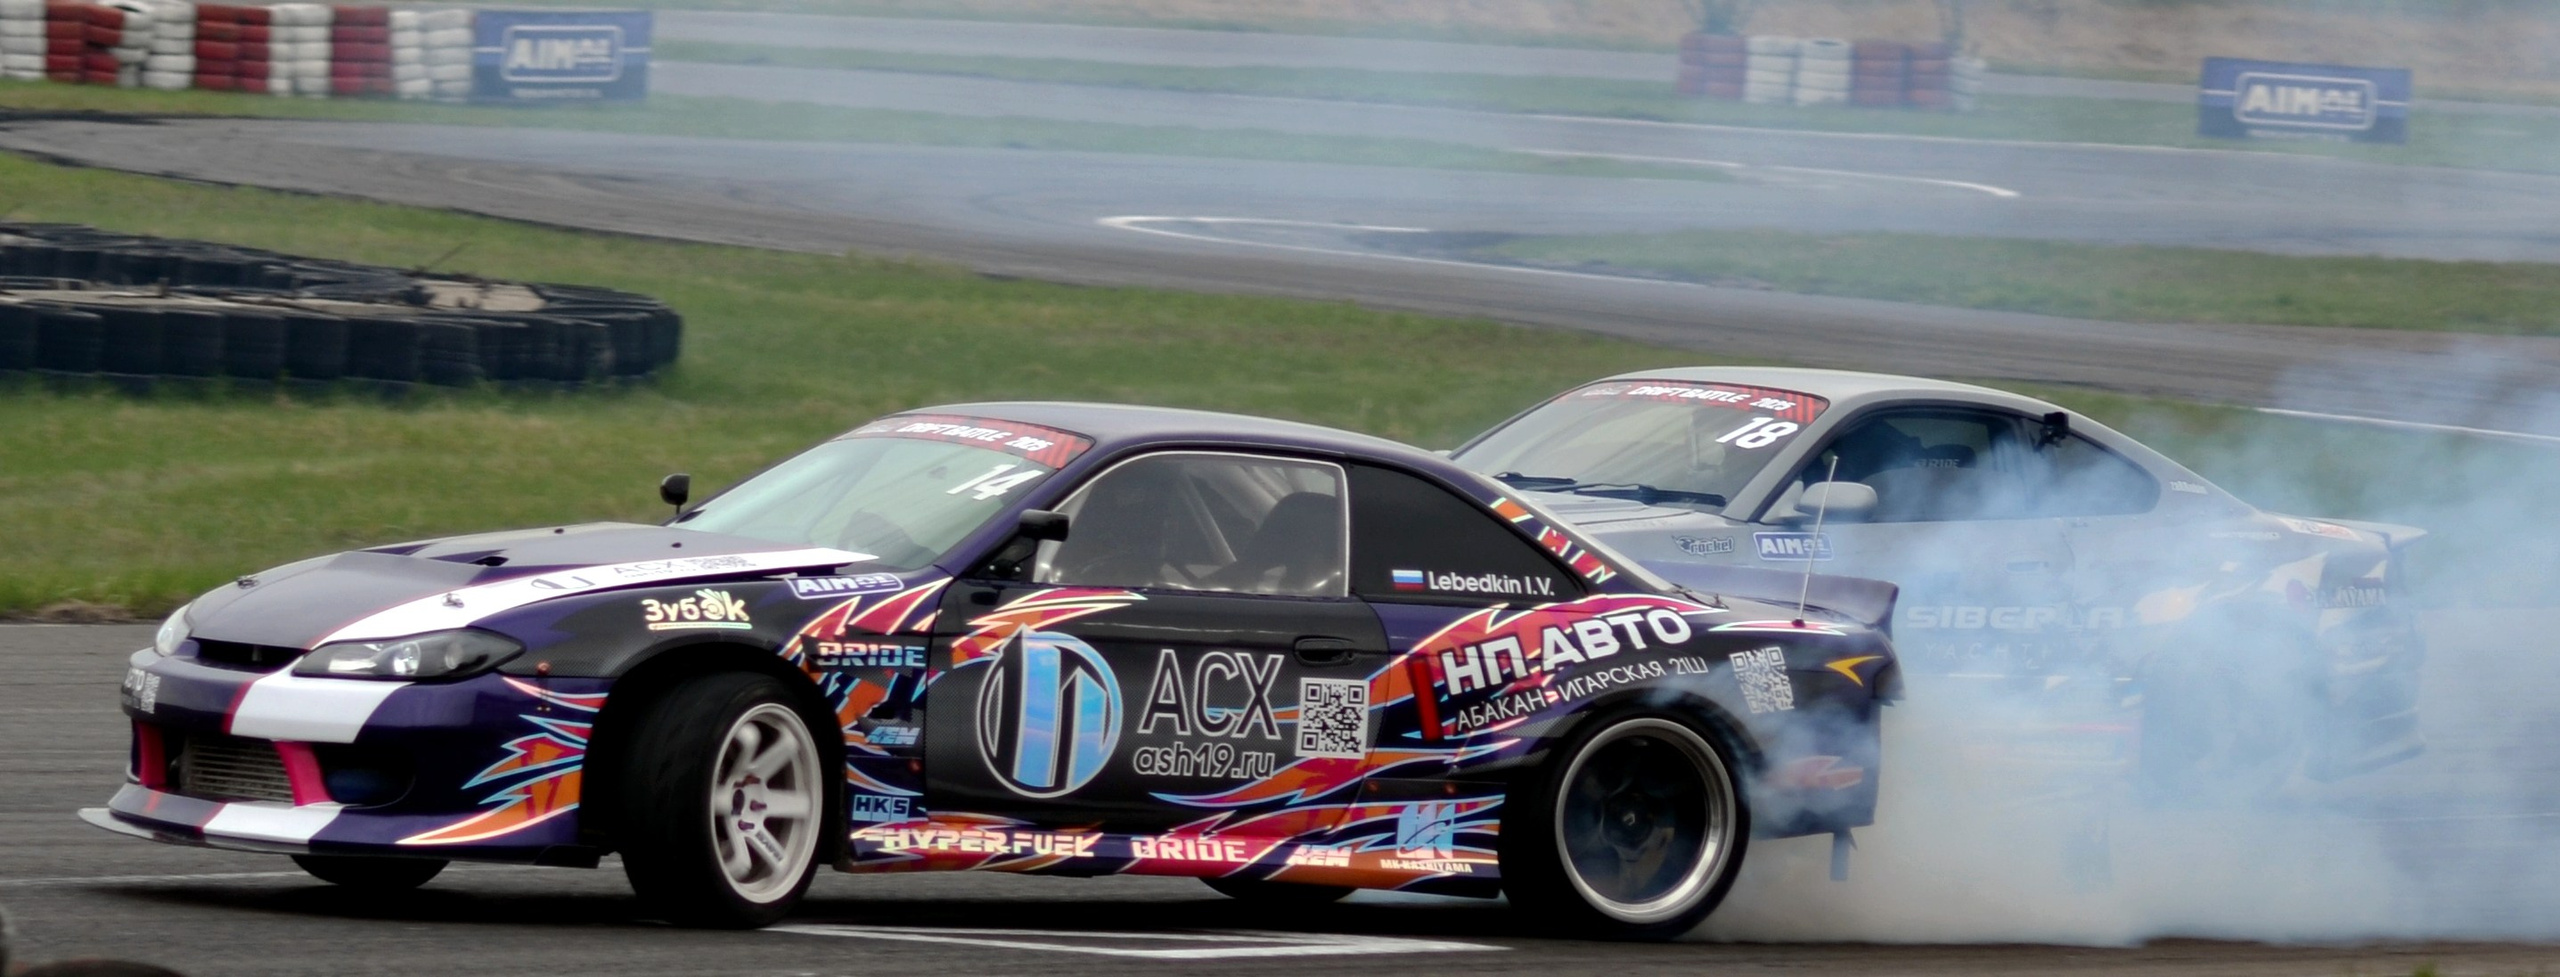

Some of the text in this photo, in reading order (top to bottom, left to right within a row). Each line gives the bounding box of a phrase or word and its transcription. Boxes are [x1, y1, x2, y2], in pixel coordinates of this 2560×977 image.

[1715, 416, 1798, 449] 18
[946, 464, 1044, 500] 14
[1429, 570, 1555, 596] Lebedkin I.V.
[816, 642, 926, 667] BRIDE
[1541, 608, 1692, 672] АВТО
[1456, 688, 1547, 733] АБАКАН
[1557, 659, 1668, 702] ИГАРСКАЯ
[1133, 741, 1276, 779] ash19.ru
[856, 796, 907, 815] HKS
[1130, 837, 1249, 863] BRIDE
